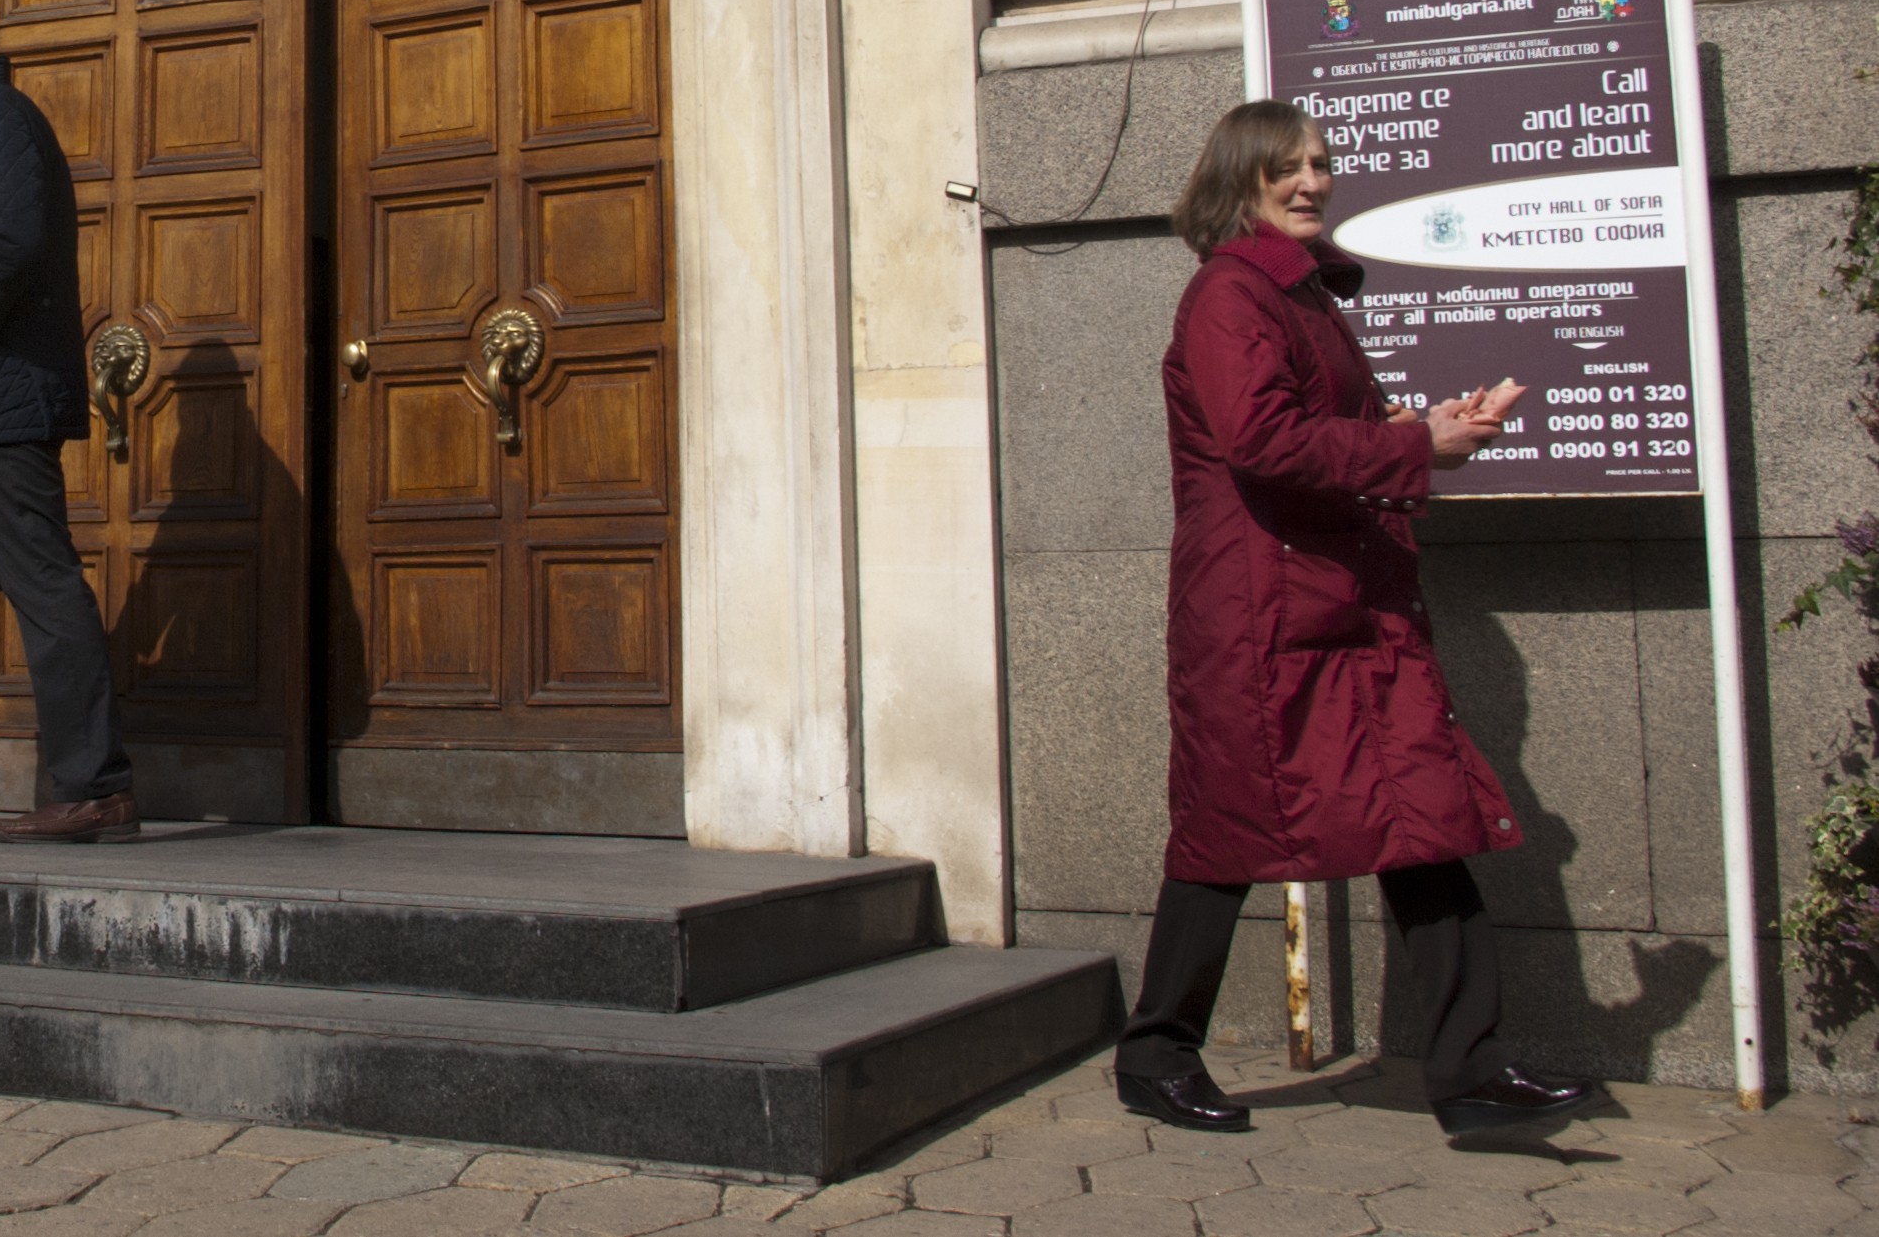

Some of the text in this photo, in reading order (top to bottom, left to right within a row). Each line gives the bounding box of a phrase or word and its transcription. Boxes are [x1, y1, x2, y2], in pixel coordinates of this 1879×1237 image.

[1557, 5, 1594, 19] ДЛАН
[1331, 63, 1377, 77] ОБЕКТЪТ
[1381, 61, 1388, 72] Е
[1528, 43, 1600, 59] НАСЛЕДСТВО
[1602, 68, 1648, 94] Call
[1421, 88, 1450, 109] се
[1522, 103, 1650, 131] and learn
[1491, 129, 1652, 163] more about
[1399, 149, 1430, 170] за
[1508, 195, 1663, 217] CITY HALL OF SOFIA
[1482, 223, 1665, 248] КМЕТСТВО СОФИЯ
[1363, 292, 1428, 308] всички
[1437, 285, 1519, 304] мобилни
[1528, 281, 1634, 301] оператори
[1364, 302, 1603, 327] for all mobile operators
[1554, 325, 1624, 339] FOR ENGLISH
[1583, 362, 1649, 375] ENGLISH
[1546, 384, 1687, 404] 0900 01 320
[1548, 412, 1689, 432] 0900 80 320
[1549, 442, 1606, 459] 0900
[1612, 440, 1639, 457] 91
[1648, 439, 1690, 456] 320
